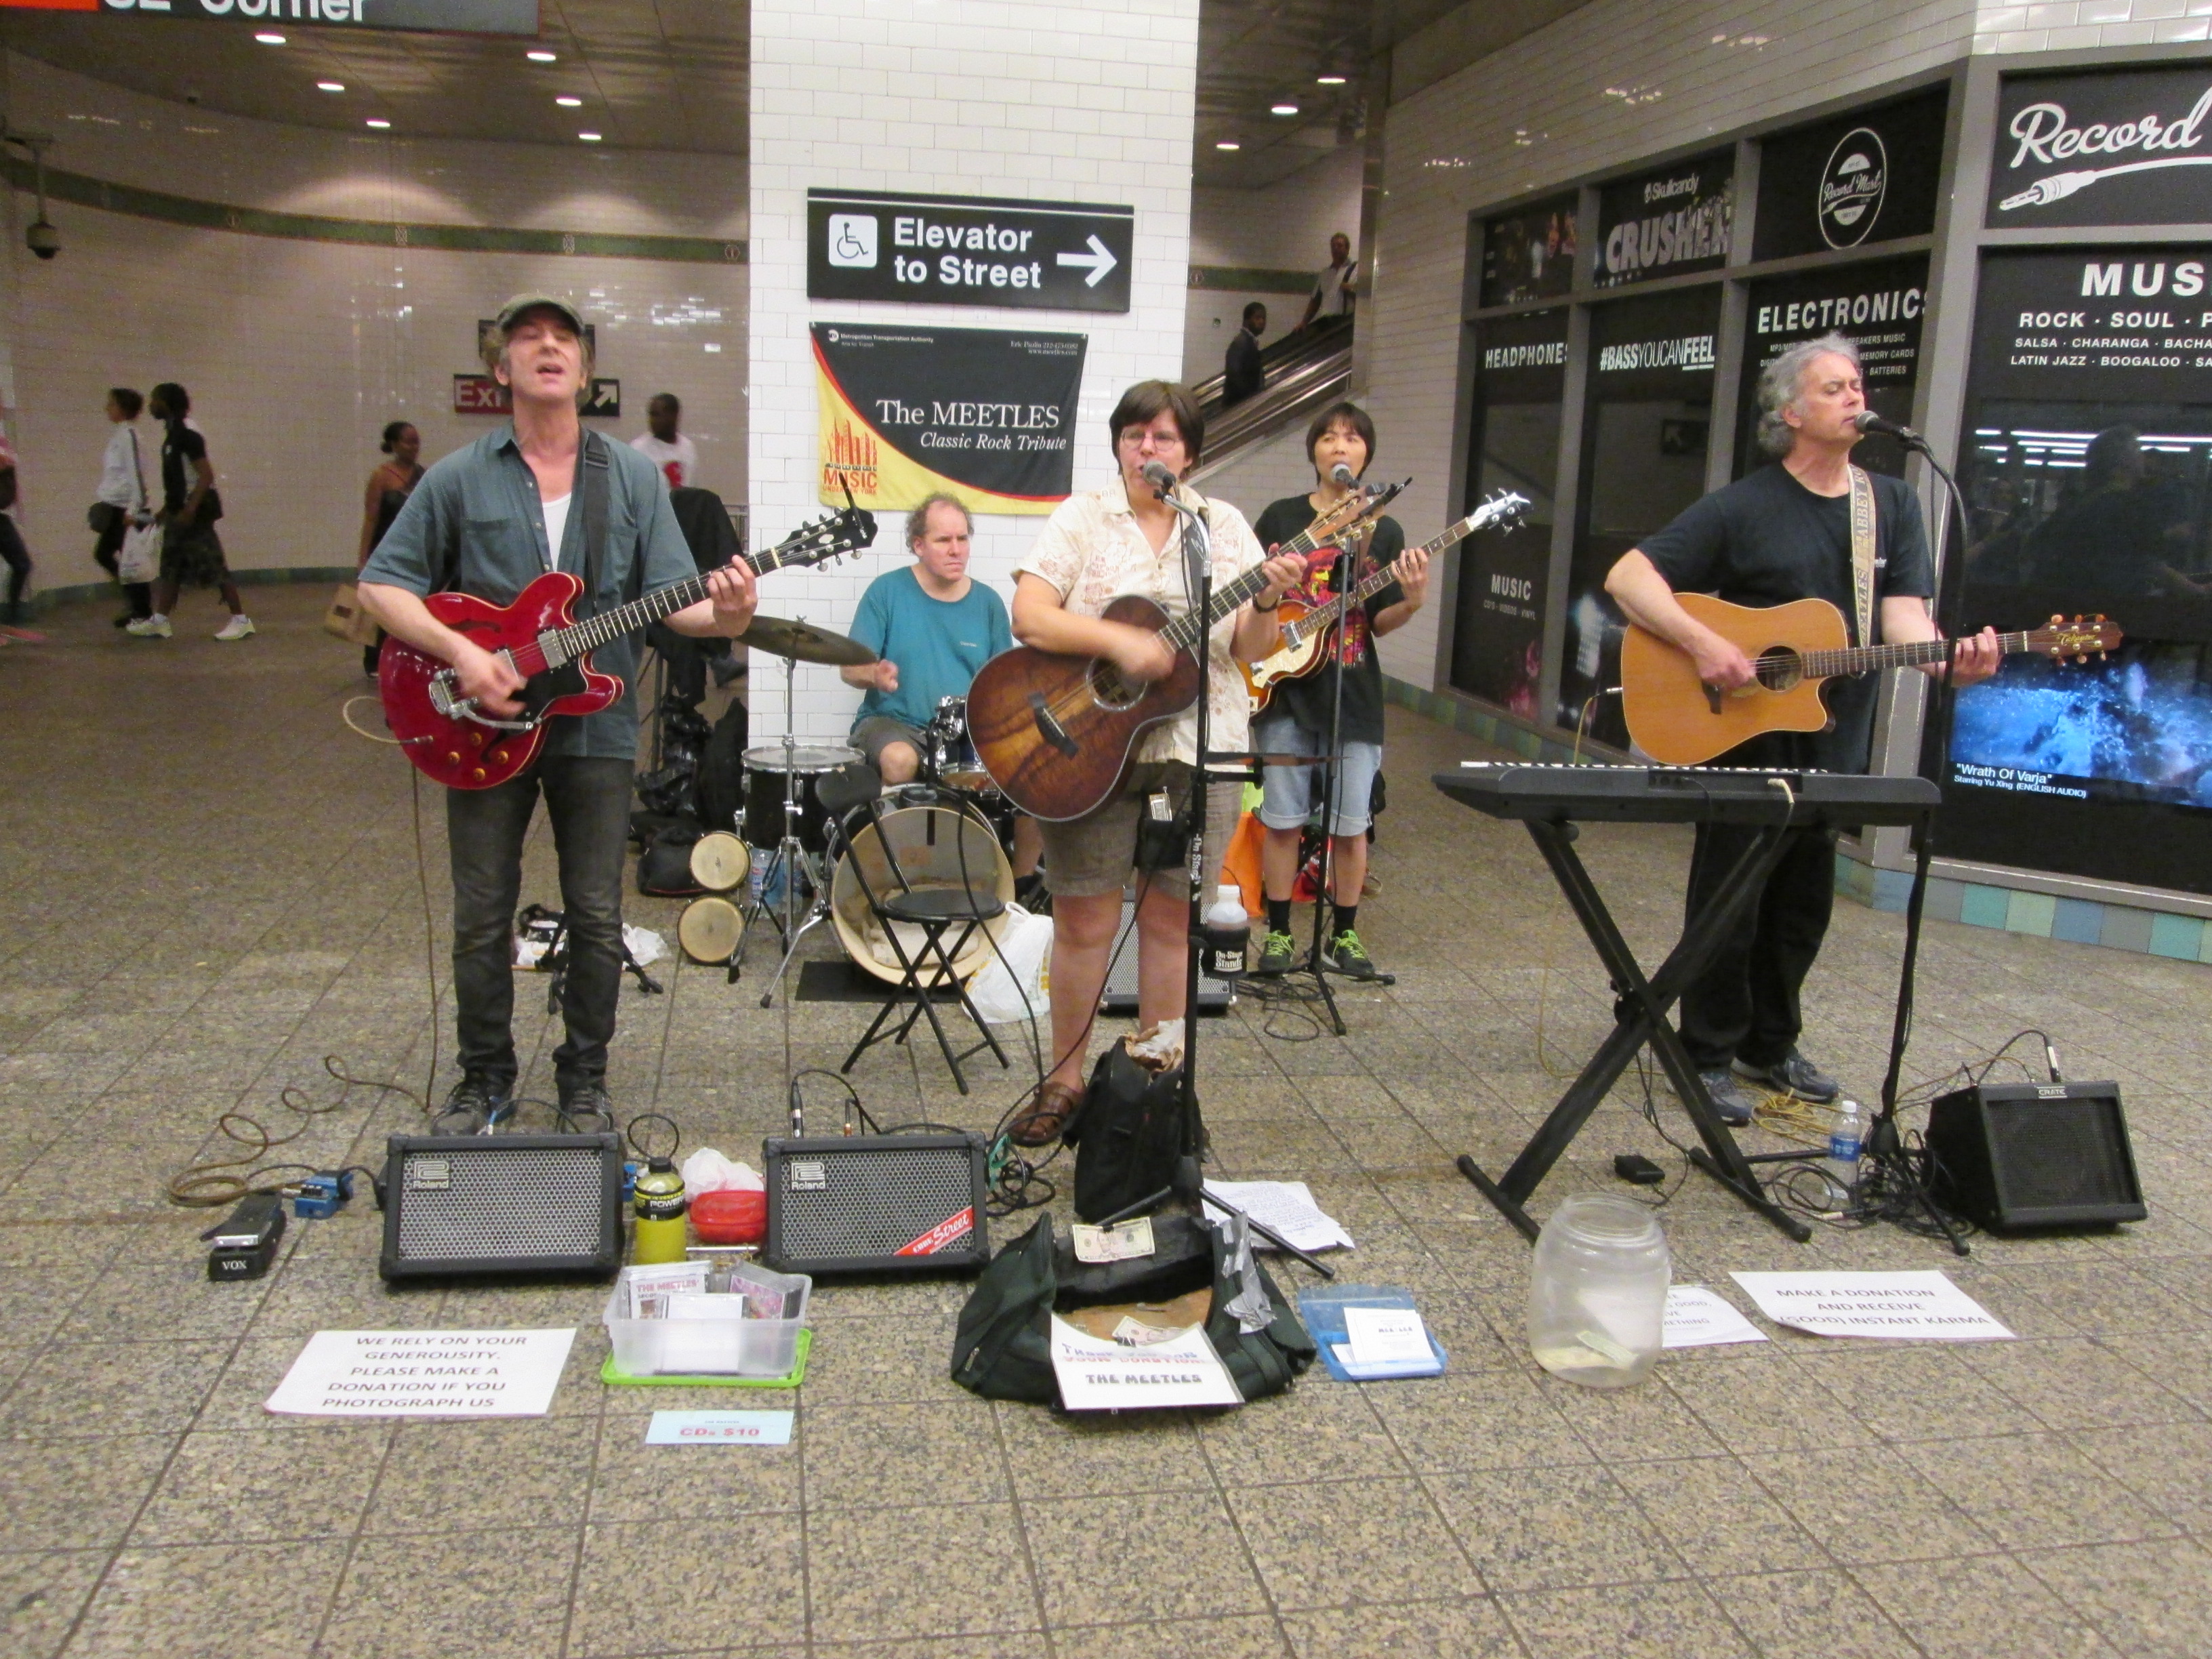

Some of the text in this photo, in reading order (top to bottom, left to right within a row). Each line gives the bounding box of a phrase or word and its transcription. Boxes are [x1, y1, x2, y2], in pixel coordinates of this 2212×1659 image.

[2010, 86, 2212, 168] Record
[1824, 169, 1882, 203] Record Mart
[895, 216, 1032, 251] Elevator
[895, 255, 1041, 288] to Street
[2081, 262, 2212, 297] MUS
[2019, 312, 2086, 328] ROCK
[2110, 312, 2174, 328] SOUL
[1883, 333, 1906, 343] MUSIC
[2015, 337, 2058, 348] SALSA
[2071, 337, 2150, 349] CHARANGA
[1599, 335, 1715, 371] #BASSYOUCANFEEL
[1860, 351, 1889, 361] MEMORY
[1890, 348, 1914, 359] CARDS
[2010, 355, 2048, 366] LATIN
[2051, 356, 2087, 367] JAZZ
[2101, 356, 2181, 367] BOOGALOO
[1870, 366, 1906, 376] BATTERIES
[455, 381, 501, 407] Exi
[876, 400, 1059, 428] The MEETLES
[920, 431, 1067, 451] Classic Rock Tribute
[1856, 486, 1869, 539] ABBEY
[1492, 573, 1532, 600] MUSIC
[1957, 763, 2052, 785] "Wrath Of Varja"
[1954, 775, 1983, 787] Starring
[1996, 781, 2013, 790] Xing
[2016, 783, 2055, 794] (ENGLISH
[2056, 787, 2087, 799] AUDIO)
[1216, 958, 1242, 968] Stands
[413, 1180, 449, 1189] Roland
[792, 1180, 825, 1190] Roland
[933, 1213, 969, 1246] Street
[222, 1260, 247, 1270] VOX
[1848, 1317, 1920, 1325] INSTANT
[356, 1336, 527, 1345] WE RELY ON YOUR
[365, 1351, 501, 1360] GENEROUSITY.
[350, 1366, 499, 1376] PLEASE MAKE A
[1086, 1374, 1203, 1384] THE MEETLES
[327, 1382, 506, 1391] DONATION IF YOU
[321, 1398, 495, 1407] PHOTOGRAPH US
[680, 1427, 760, 1437] CDs $10
